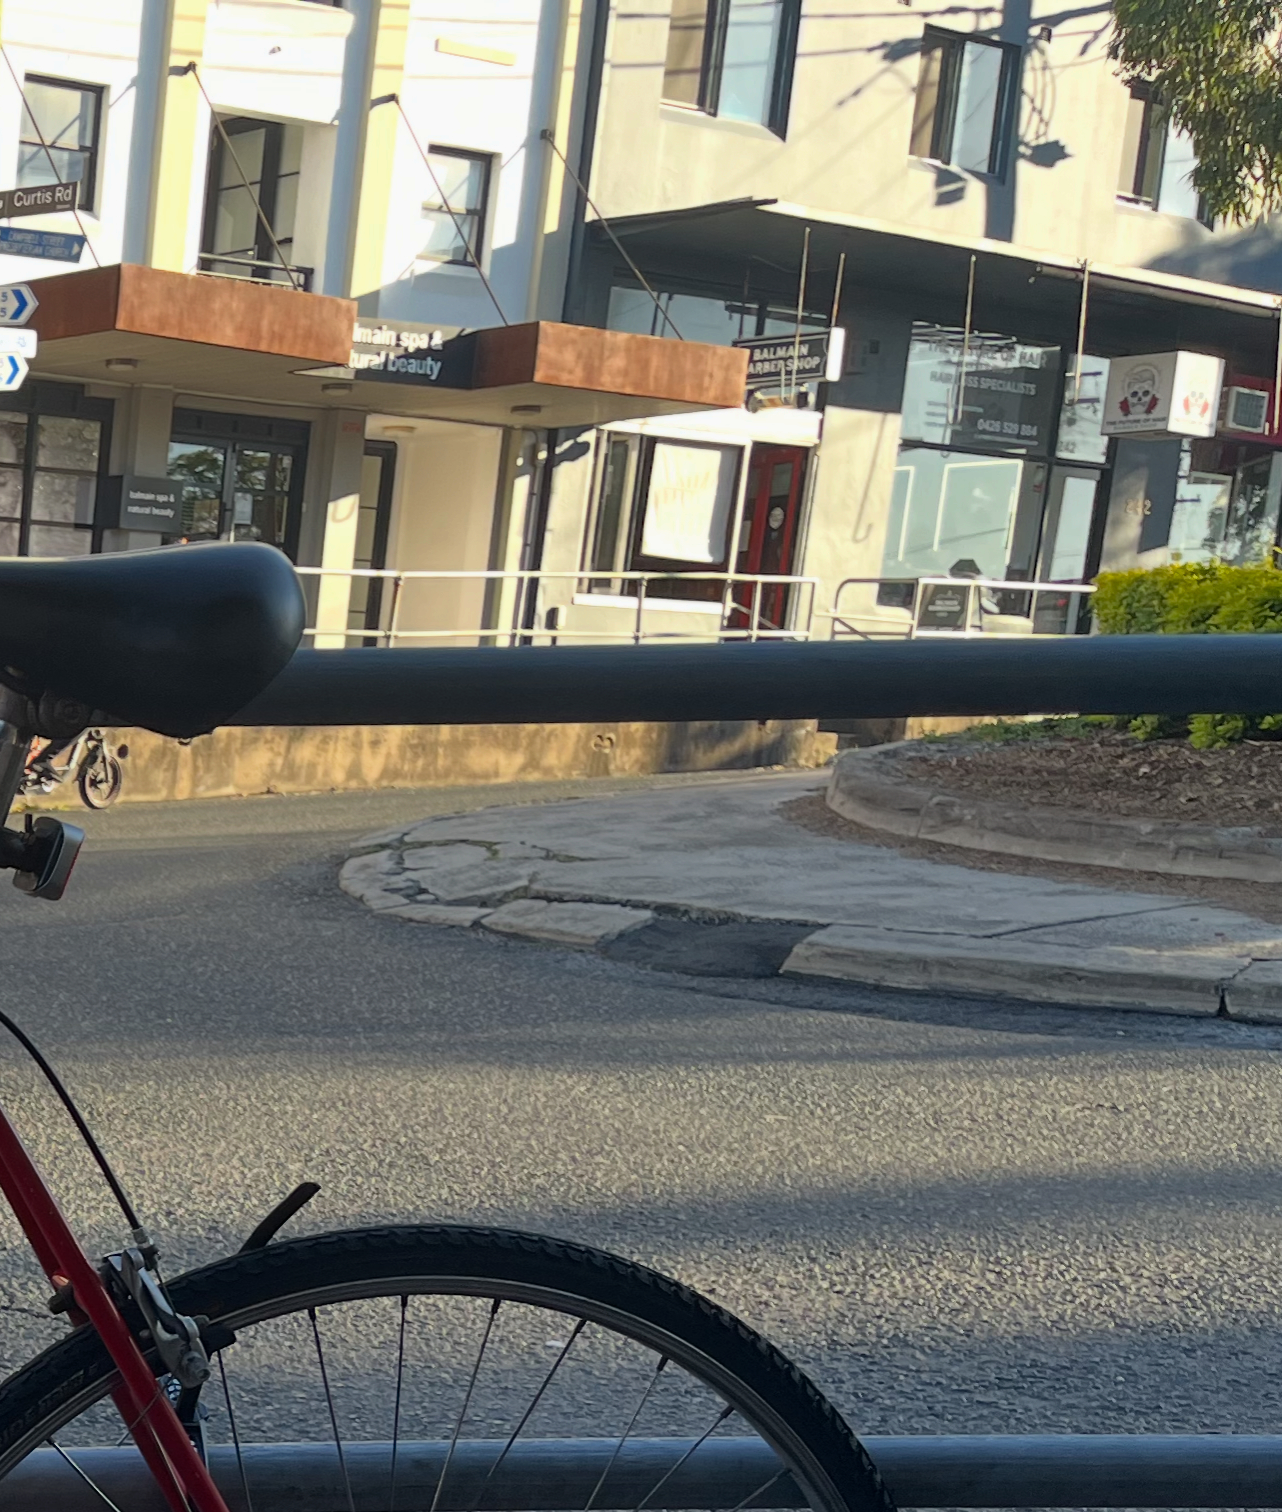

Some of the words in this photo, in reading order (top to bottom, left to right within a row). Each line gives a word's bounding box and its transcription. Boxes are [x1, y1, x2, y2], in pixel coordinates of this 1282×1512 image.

[13, 188, 53, 207] Curtis
[55, 185, 73, 202] Rd
[353, 322, 397, 347] lmain
[399, 330, 431, 353] spa
[430, 329, 444, 350] &
[753, 343, 810, 361] BALMAN
[349, 349, 386, 371] tural
[387, 351, 442, 380] beauty
[979, 377, 1037, 396] SPECIALISTS
[151, 506, 175, 519] beauty
